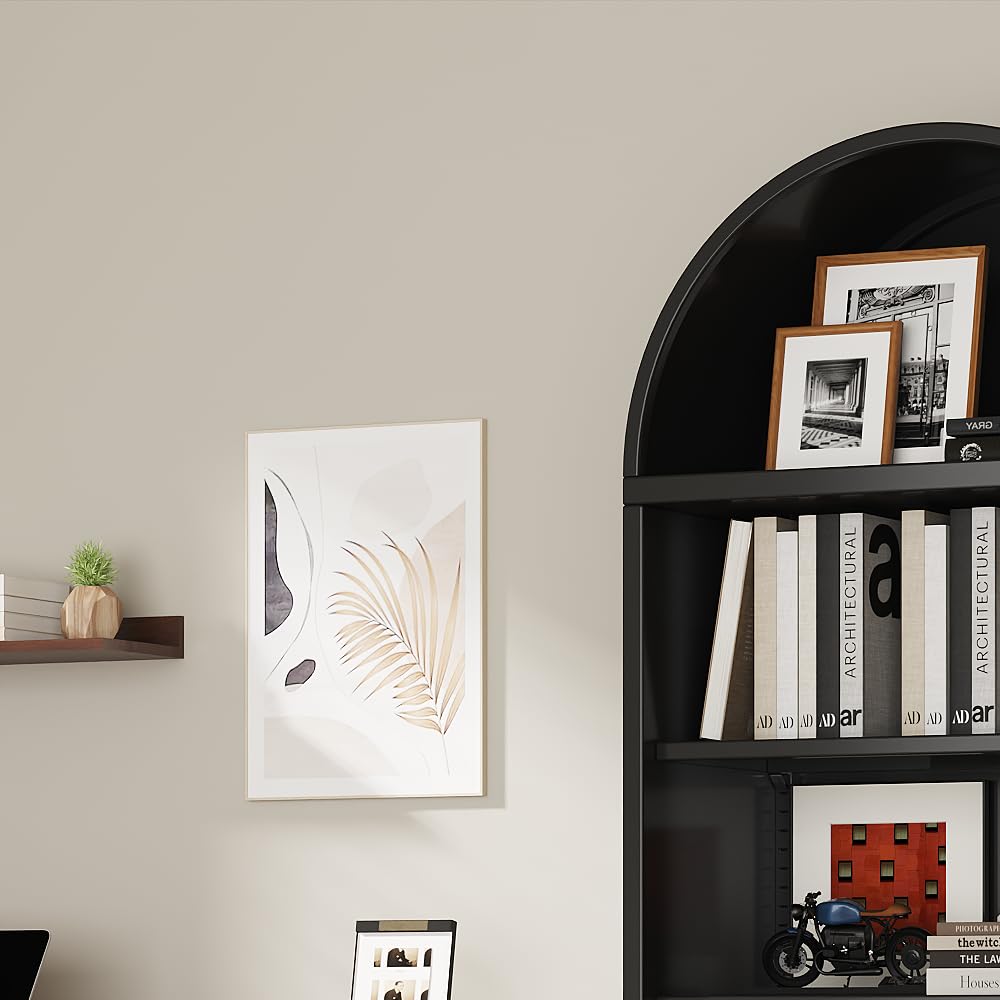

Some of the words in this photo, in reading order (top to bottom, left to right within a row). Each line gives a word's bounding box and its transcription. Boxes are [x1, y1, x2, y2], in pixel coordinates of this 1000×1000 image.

[844, 527, 857, 678] ARCHITECTURAL
[976, 521, 989, 674] ARCHITECTURAL
[800, 714, 813, 728] AD
[819, 713, 836, 727] AD
[840, 709, 862, 727] ar
[904, 711, 920, 724] AD
[927, 712, 942, 725] AD
[952, 709, 970, 724] AD
[972, 705, 994, 723] ar
[757, 716, 773, 729] AD
[779, 716, 794, 729] AD
[960, 955, 980, 964] THE
[960, 975, 999, 989] Houses
